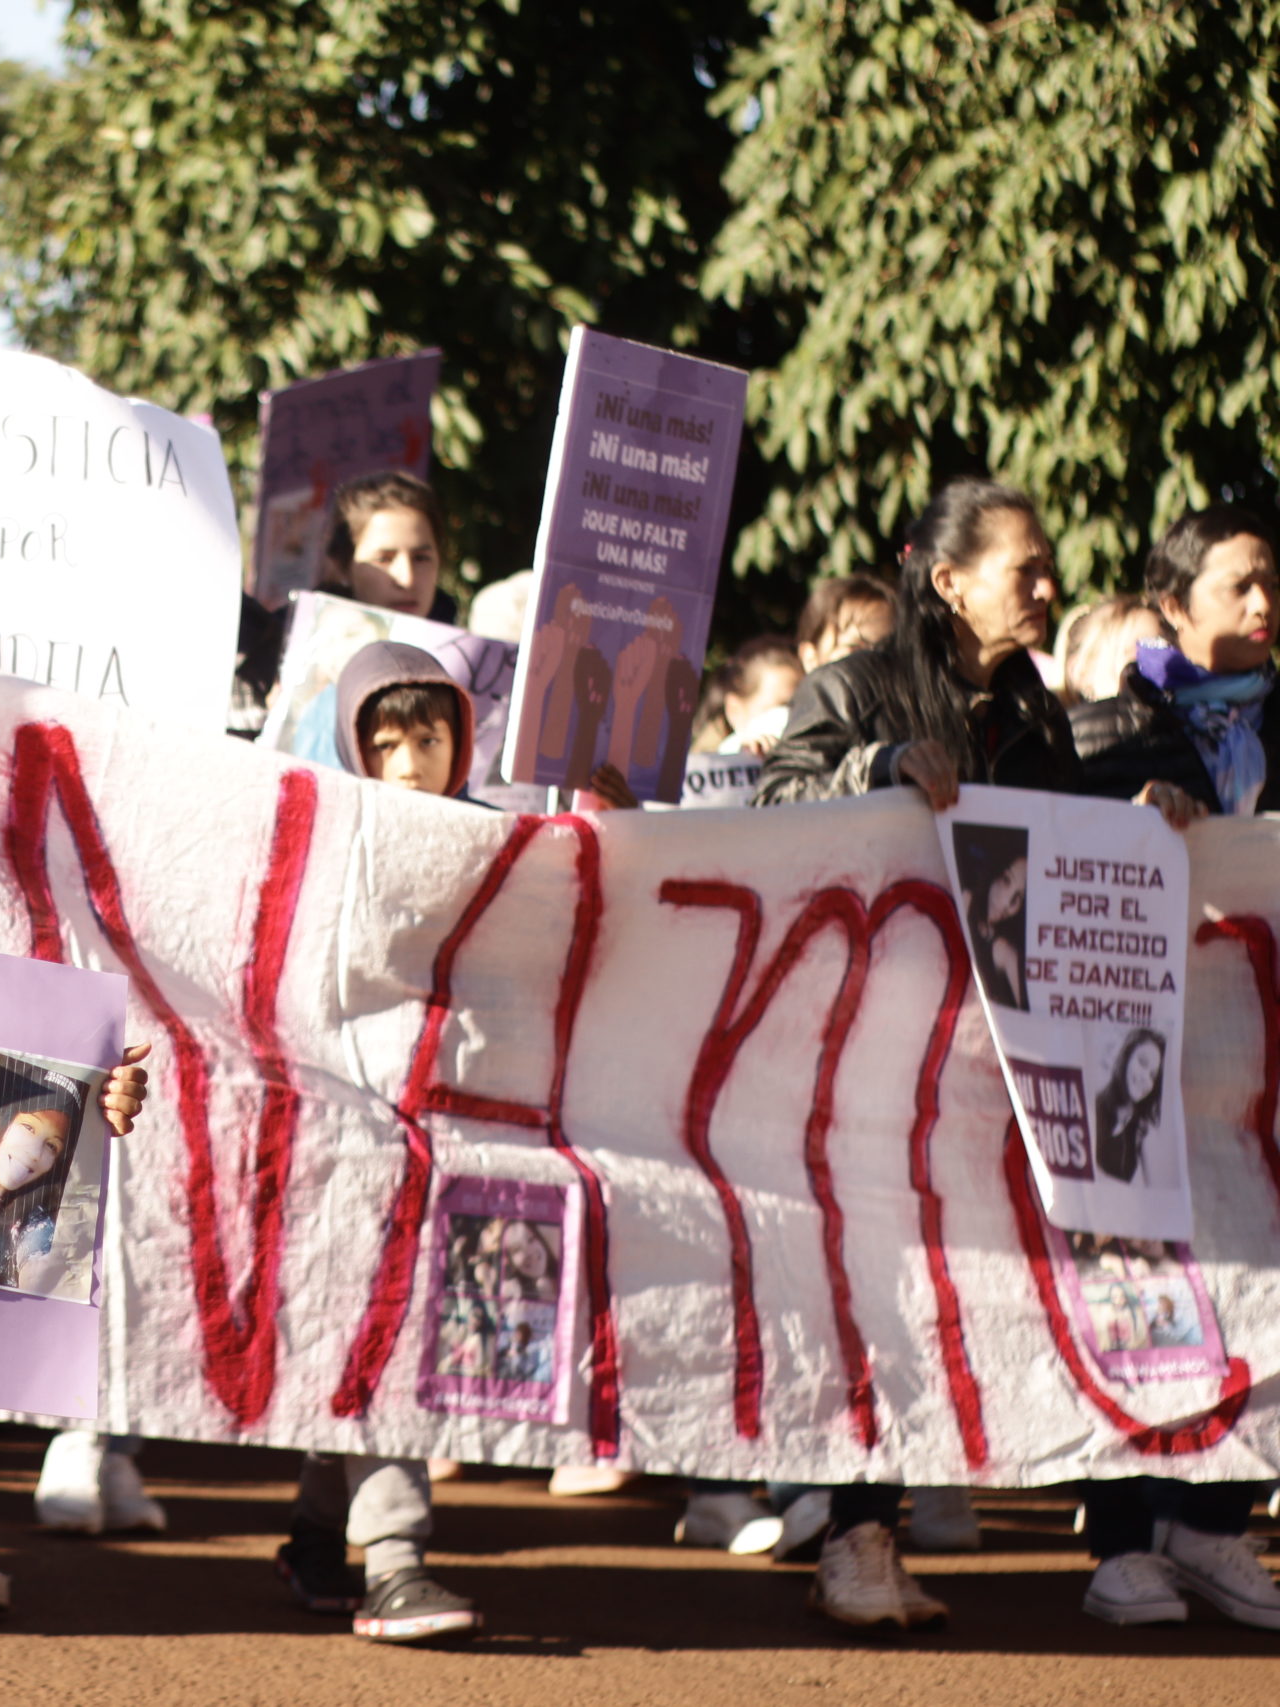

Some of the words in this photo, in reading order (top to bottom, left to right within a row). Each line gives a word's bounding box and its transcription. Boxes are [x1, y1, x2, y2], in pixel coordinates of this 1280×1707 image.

[626, 405, 662, 434] una
[666, 414, 715, 446] más!
[621, 444, 658, 473] una
[660, 452, 710, 485] más!
[613, 484, 649, 512] una
[652, 491, 702, 522] más!
[582, 508, 618, 537] ¡QUE
[620, 517, 642, 540] NO
[643, 523, 688, 552] FALTE
[596, 540, 628, 567] UNA
[631, 545, 668, 576] MÁS!
[1045, 856, 1165, 890] JUSTICIA
[1060, 891, 1110, 918] POR
[1121, 897, 1147, 922] EL
[1038, 924, 1168, 958] FEMICIDIO
[1026, 957, 1058, 982] DE
[1069, 961, 1176, 994] DANIELA
[1039, 1076, 1084, 1119] UNA
